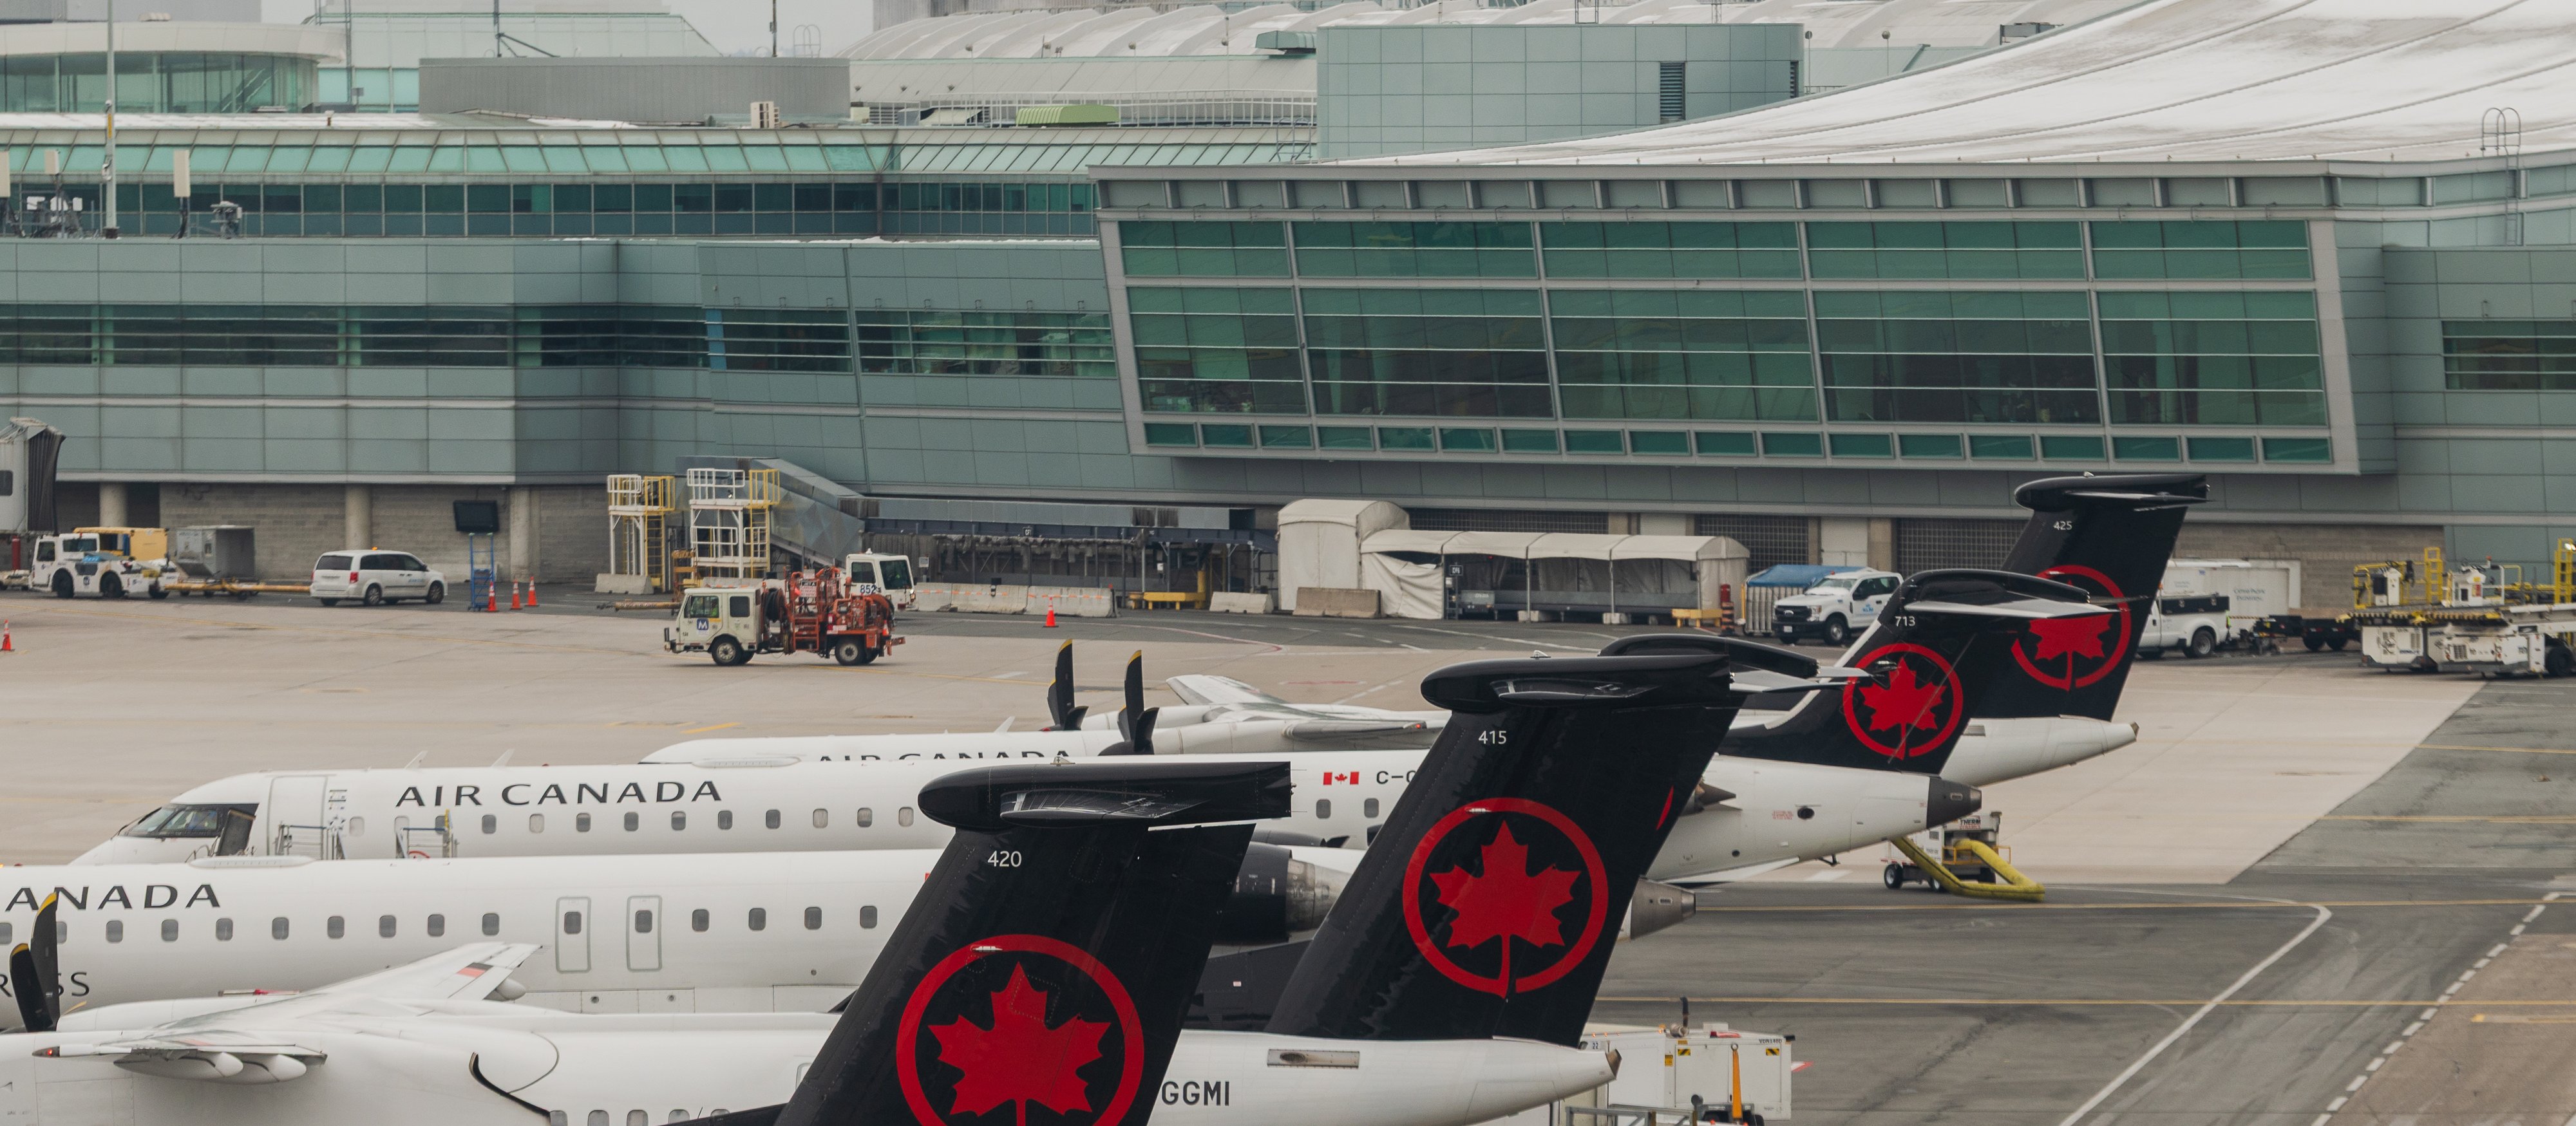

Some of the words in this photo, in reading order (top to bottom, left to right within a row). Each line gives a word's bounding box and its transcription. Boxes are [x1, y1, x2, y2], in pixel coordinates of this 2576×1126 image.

[2054, 521, 2072, 530] 425
[698, 620, 708, 629] M
[1895, 616, 1915, 626] 713
[1478, 730, 1506, 744] 415
[395, 785, 482, 807] AIR
[502, 781, 722, 806] CANADA
[987, 850, 1022, 867] 420
[5, 884, 220, 912] ANADA
[1162, 1081, 1229, 1106] GGMI
